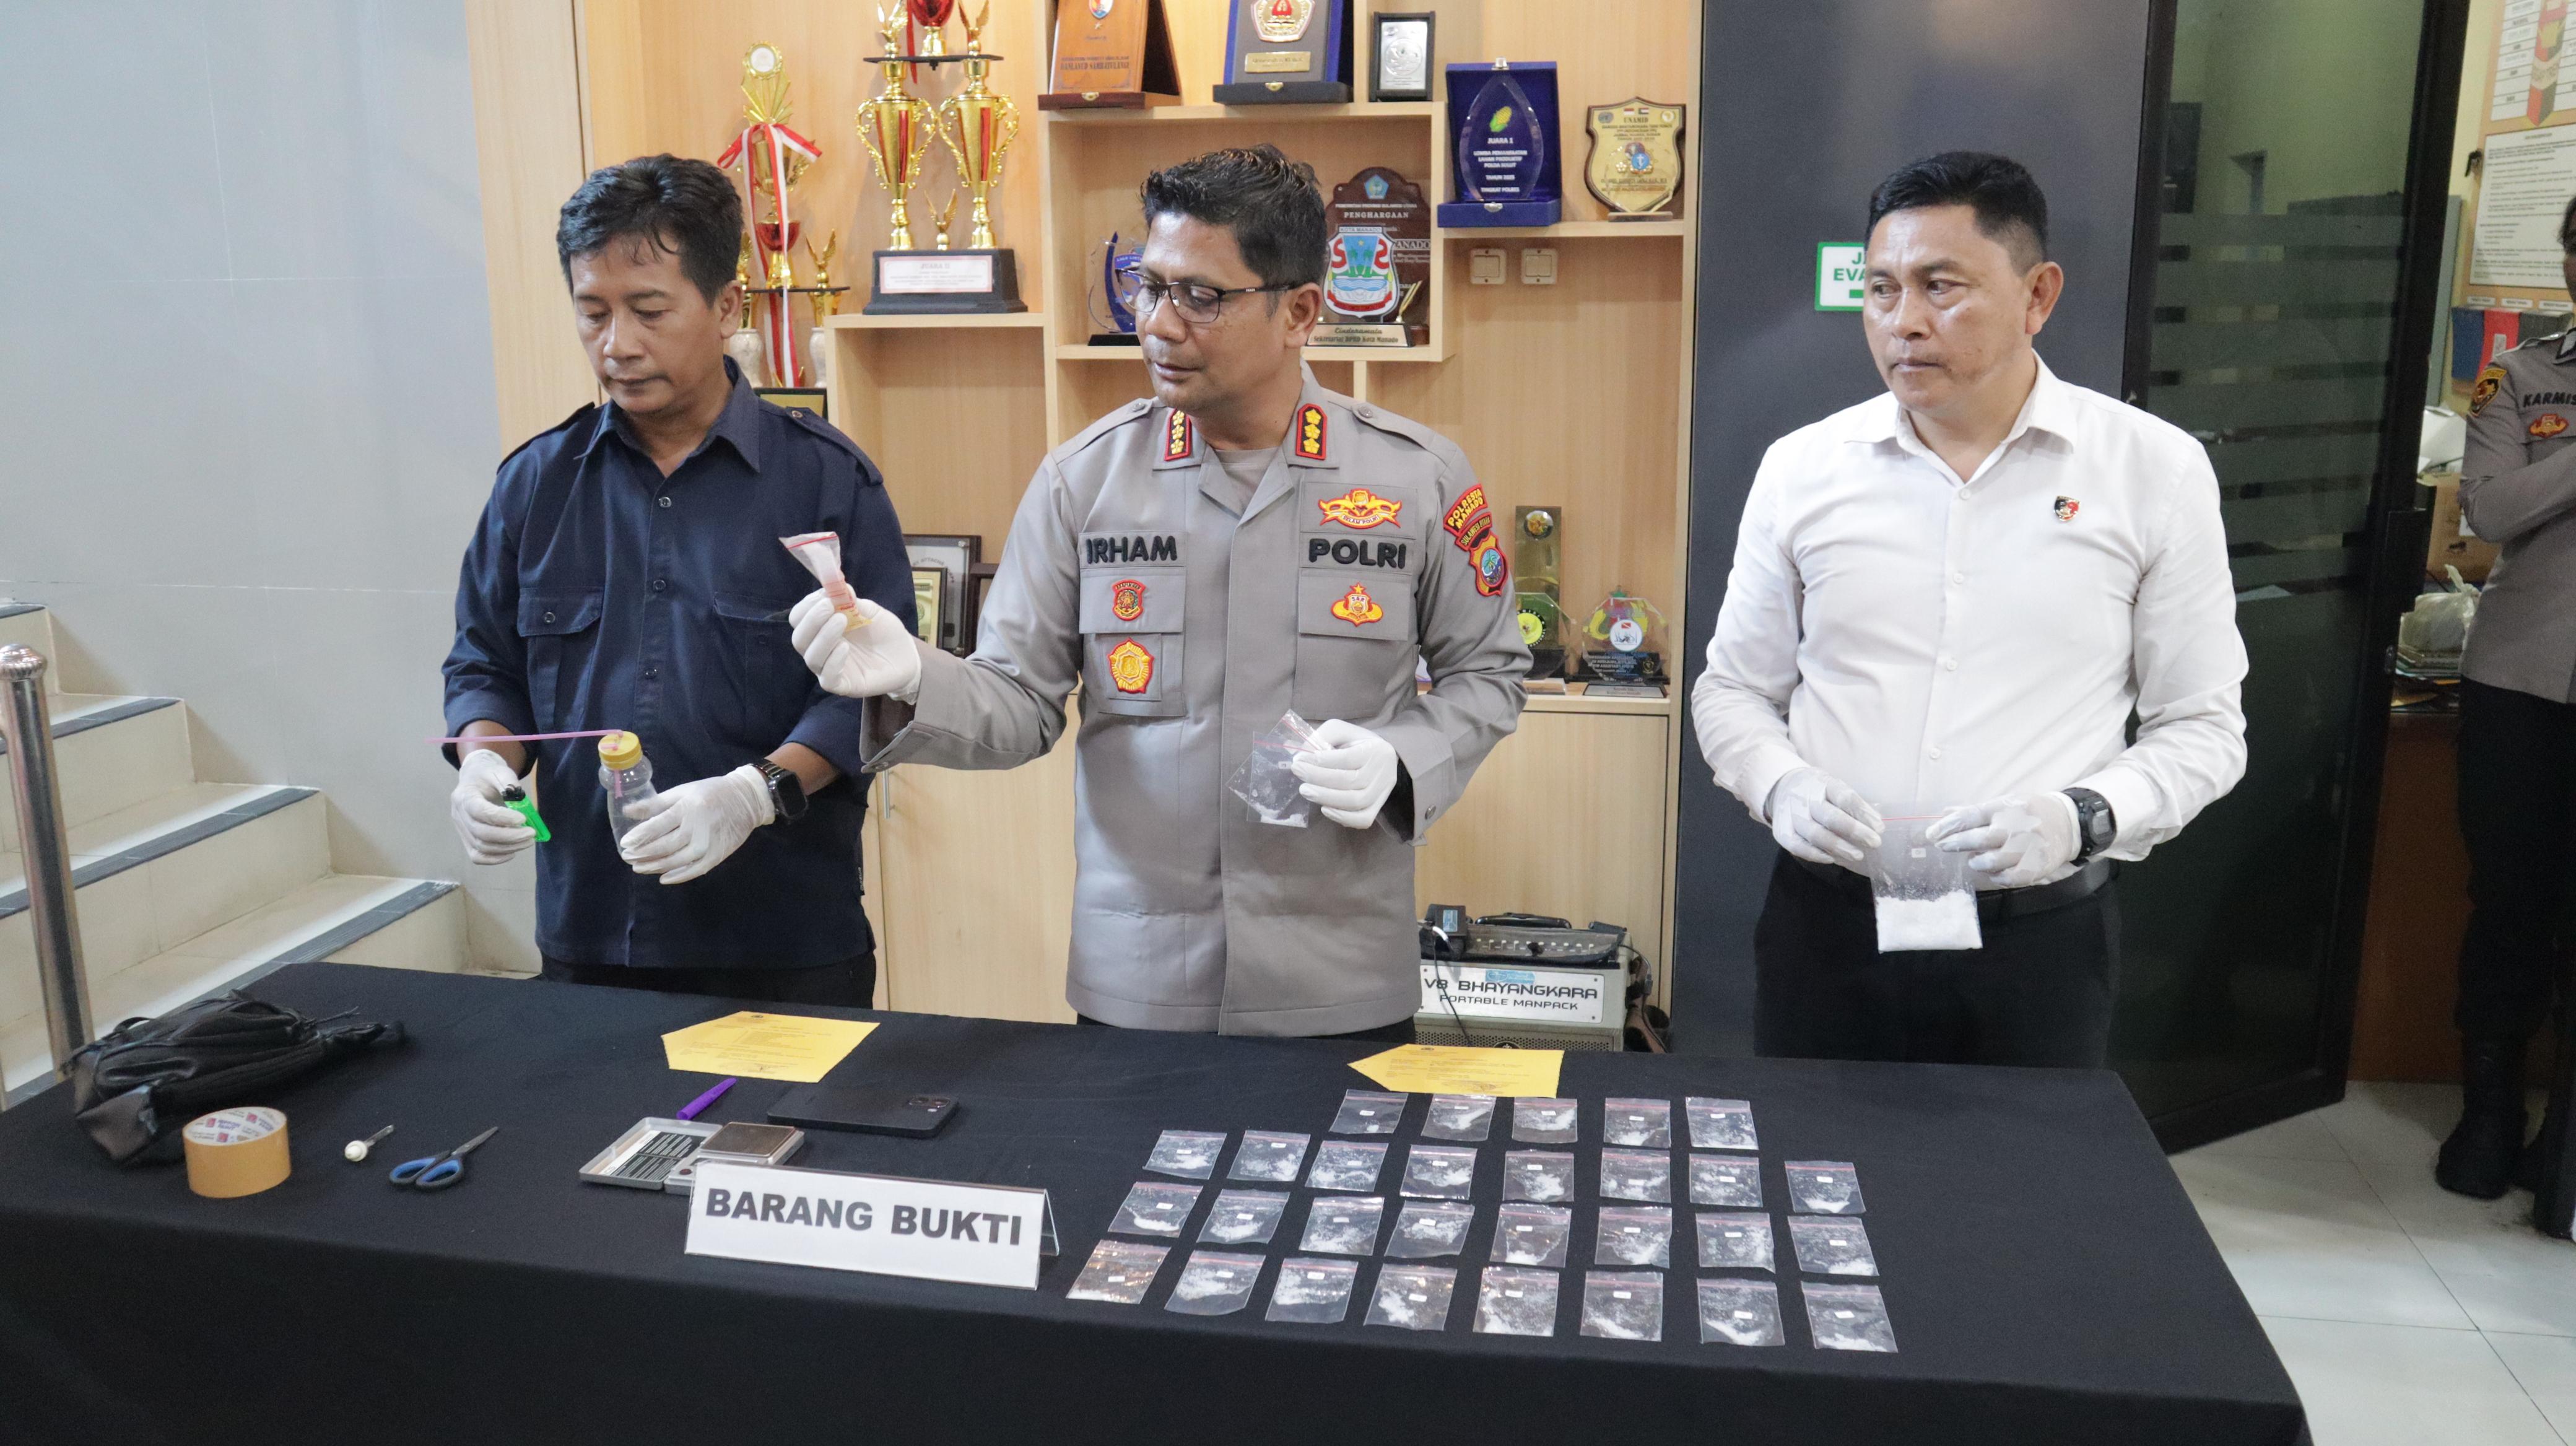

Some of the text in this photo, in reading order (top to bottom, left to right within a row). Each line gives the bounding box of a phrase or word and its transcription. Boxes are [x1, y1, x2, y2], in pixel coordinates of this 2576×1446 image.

[1362, 515, 1379, 524] POLRI
[1447, 489, 1482, 526] POLRESTA
[1455, 497, 1484, 529] MANADO
[1461, 522, 1480, 546] SULAWESI
[1086, 535, 1177, 564] IRHAM
[1308, 538, 1406, 569] POLRI
[1440, 995, 1578, 1010] PORTABLE MANPACK
[1458, 980, 1598, 999] BHAYANGKARA
[706, 1188, 1022, 1245] BARANG BUKTI
